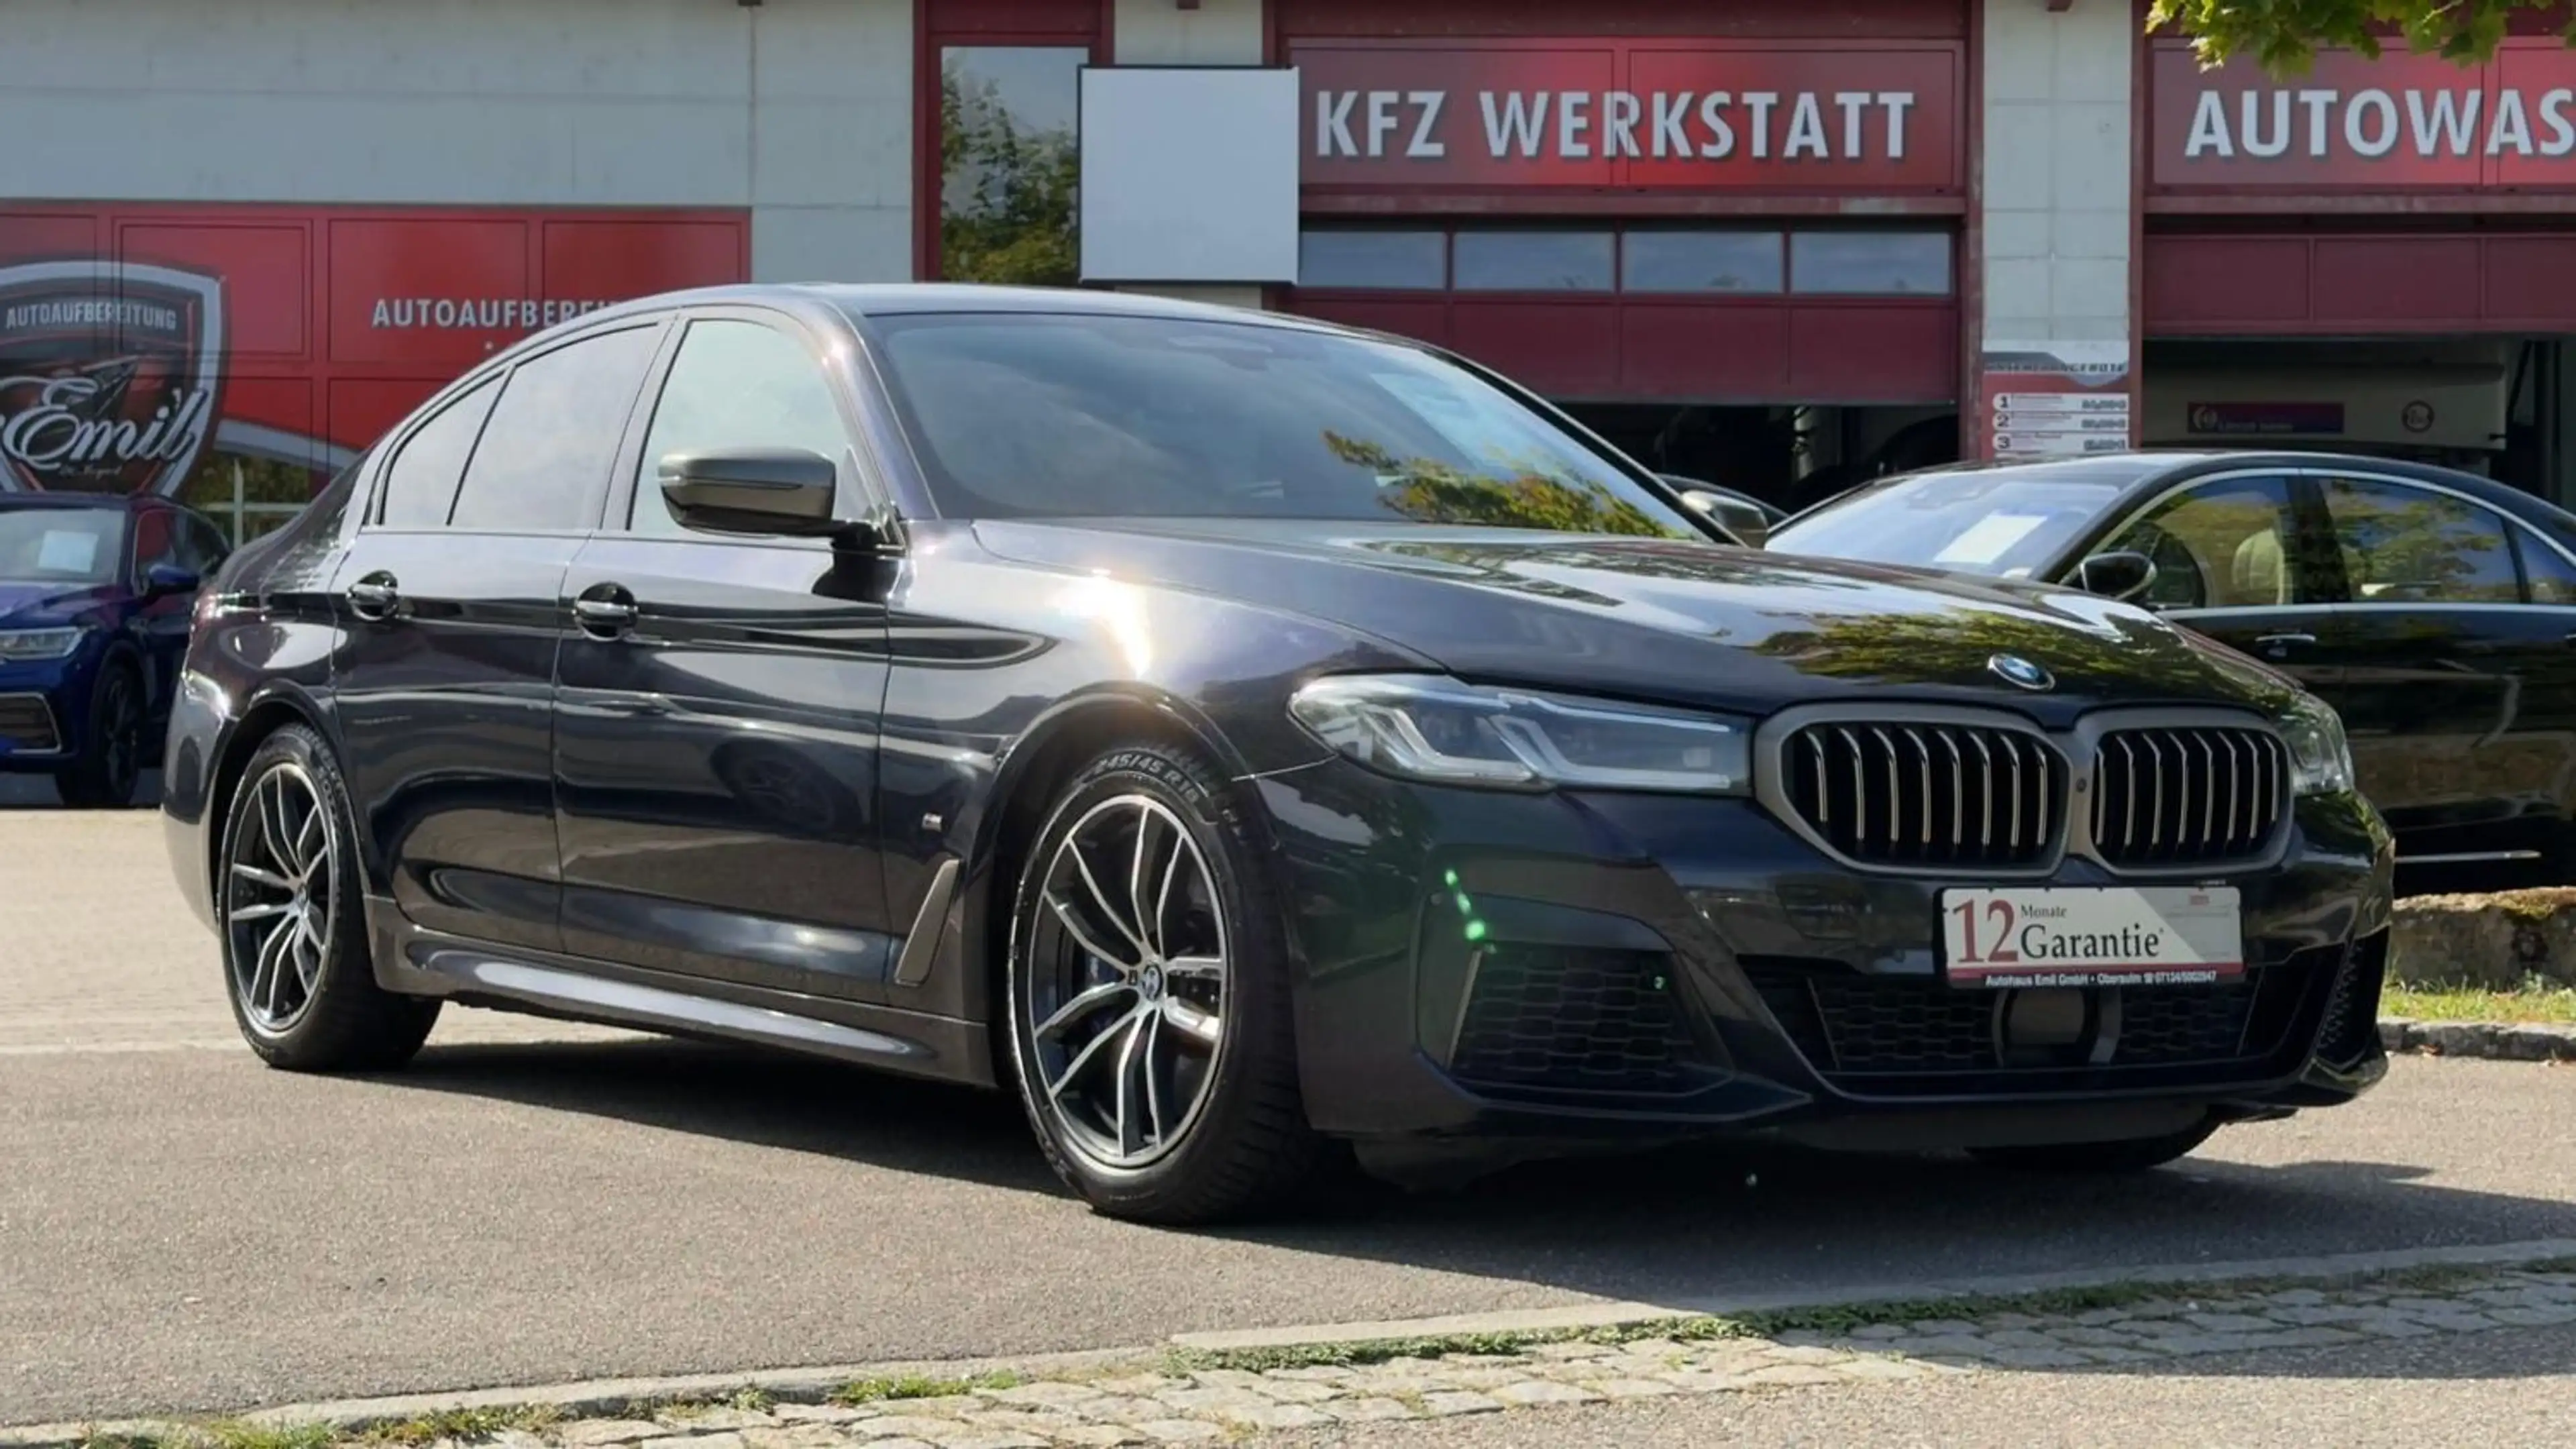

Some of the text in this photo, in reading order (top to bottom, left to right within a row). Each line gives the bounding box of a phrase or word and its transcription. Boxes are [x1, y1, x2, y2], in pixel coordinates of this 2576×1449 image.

[1317, 91, 1915, 158] KFZ WERKSTATT
[2184, 88, 2576, 157] AUTOWAS
[6, 302, 177, 331] AUTOAUFBEREITUNG
[2000, 395, 2008, 409] 1
[1996, 415, 2009, 428] 2
[1998, 436, 2010, 449] 3
[1952, 897, 2067, 963] 12 Monate
